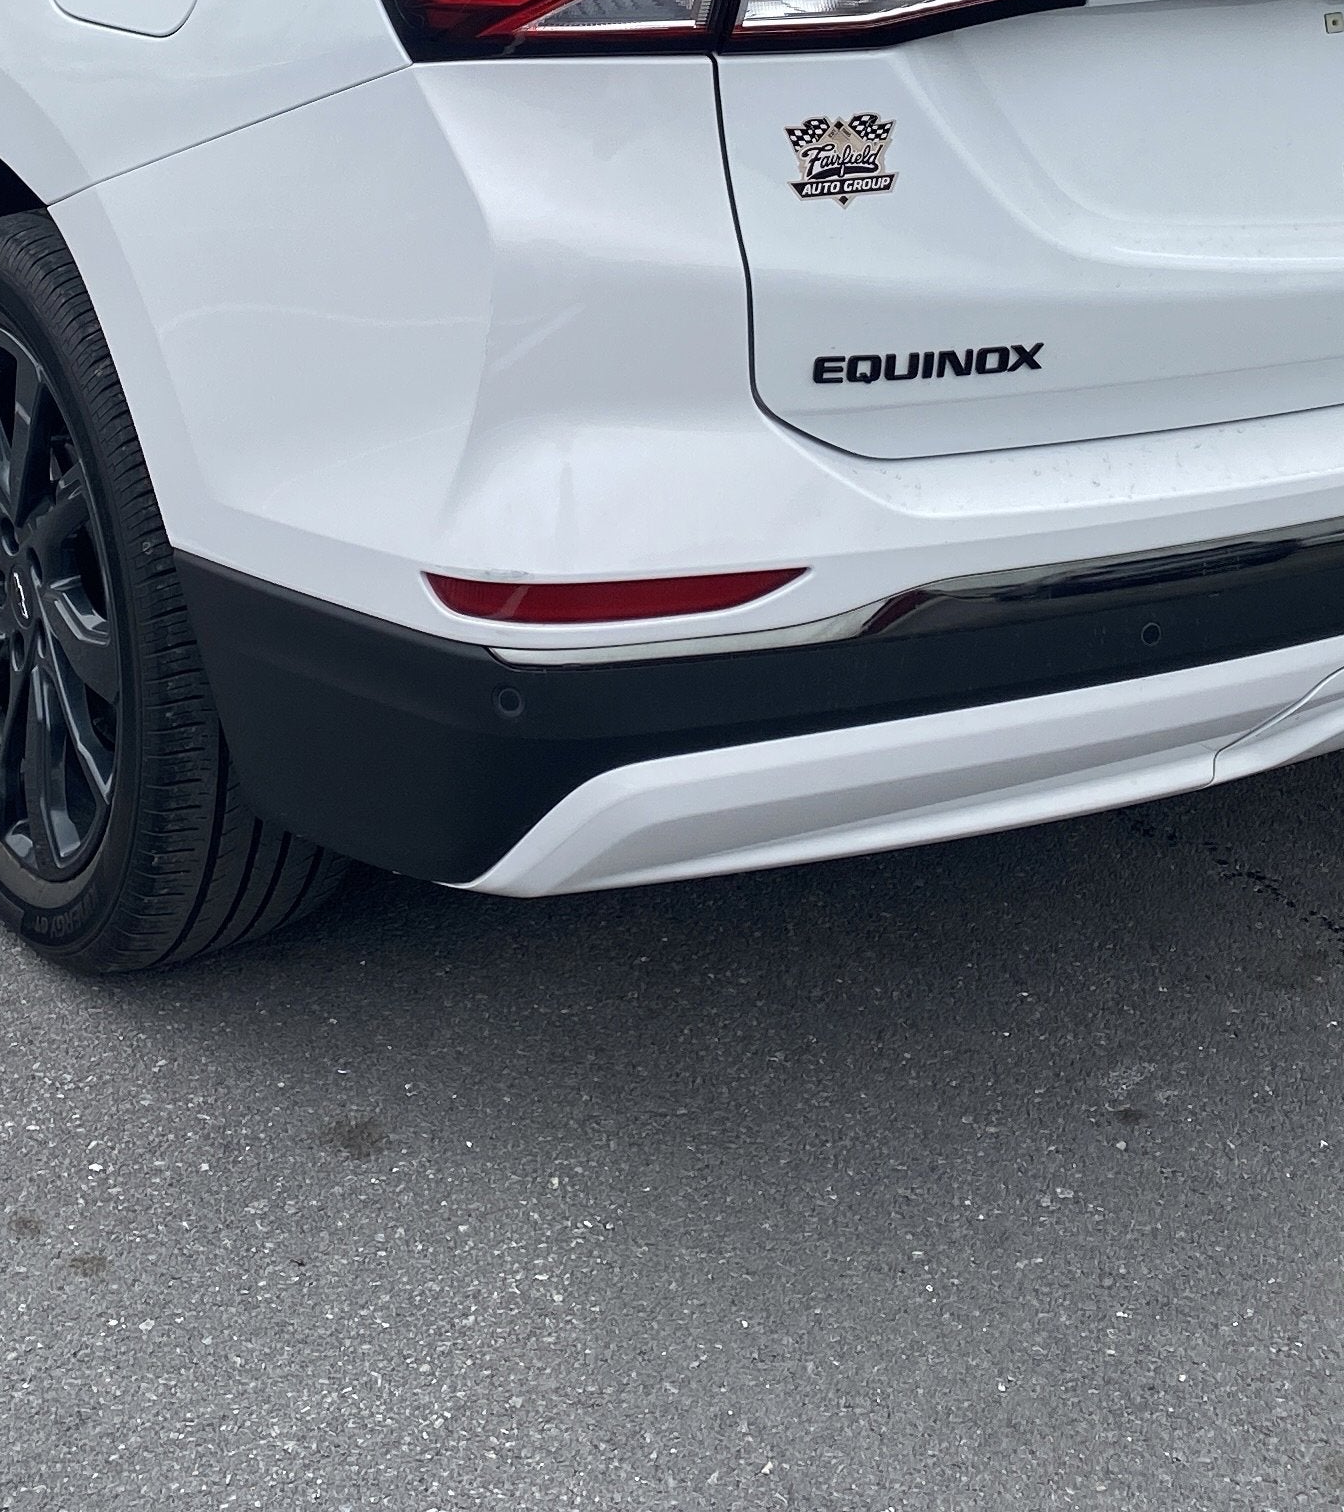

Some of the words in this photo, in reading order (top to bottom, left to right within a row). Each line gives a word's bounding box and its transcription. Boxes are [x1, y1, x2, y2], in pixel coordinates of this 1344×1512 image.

[801, 143, 884, 178] Fairfield
[802, 182, 840, 196] AUTO
[843, 177, 891, 192] GROUP
[812, 342, 1045, 384] EQUINOX
